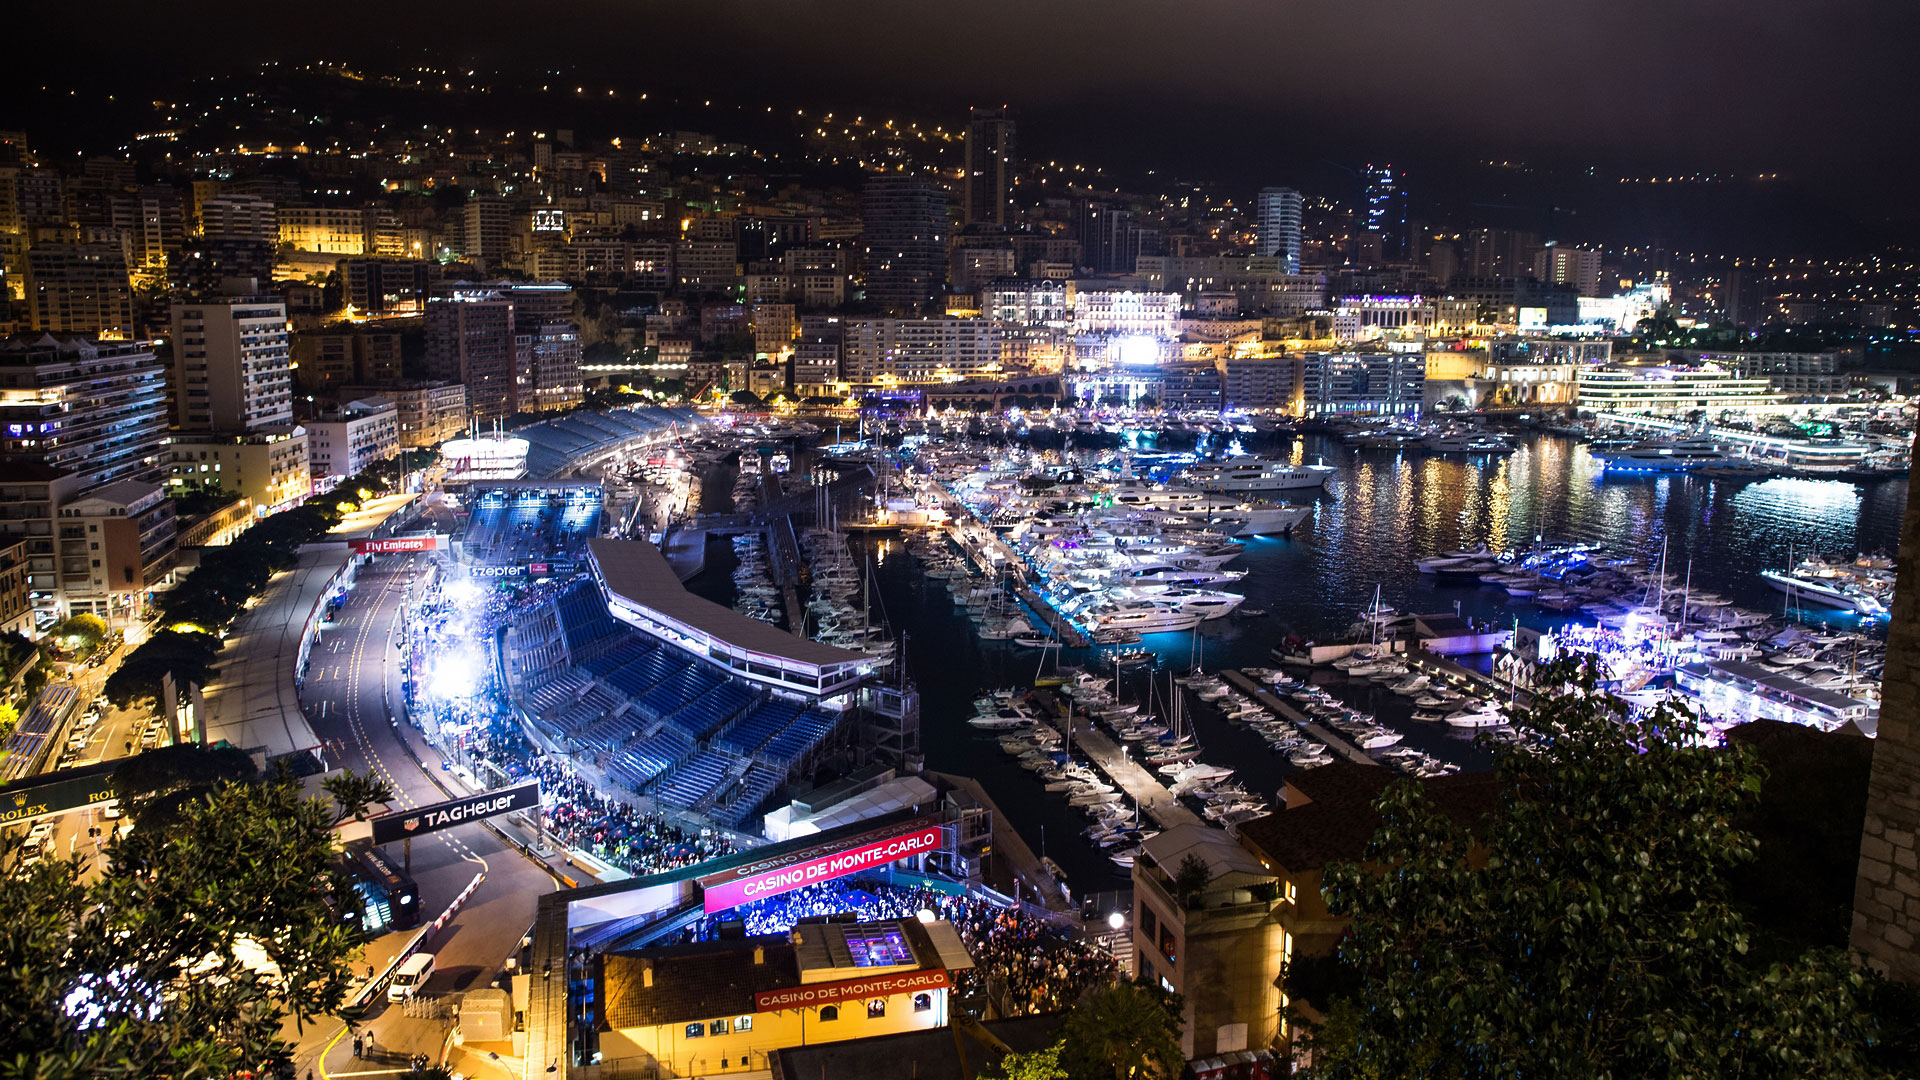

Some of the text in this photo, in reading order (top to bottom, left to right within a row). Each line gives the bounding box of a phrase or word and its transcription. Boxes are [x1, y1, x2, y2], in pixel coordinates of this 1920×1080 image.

[365, 540, 424, 552] Fly Emirates
[88, 788, 119, 803] ROL
[737, 818, 929, 876] CASINO DE MONTE-CARLO
[743, 832, 935, 896] CASINO DE MONTE-CARLO
[760, 973, 945, 1007] CASINO DE MONTE-CARLO
